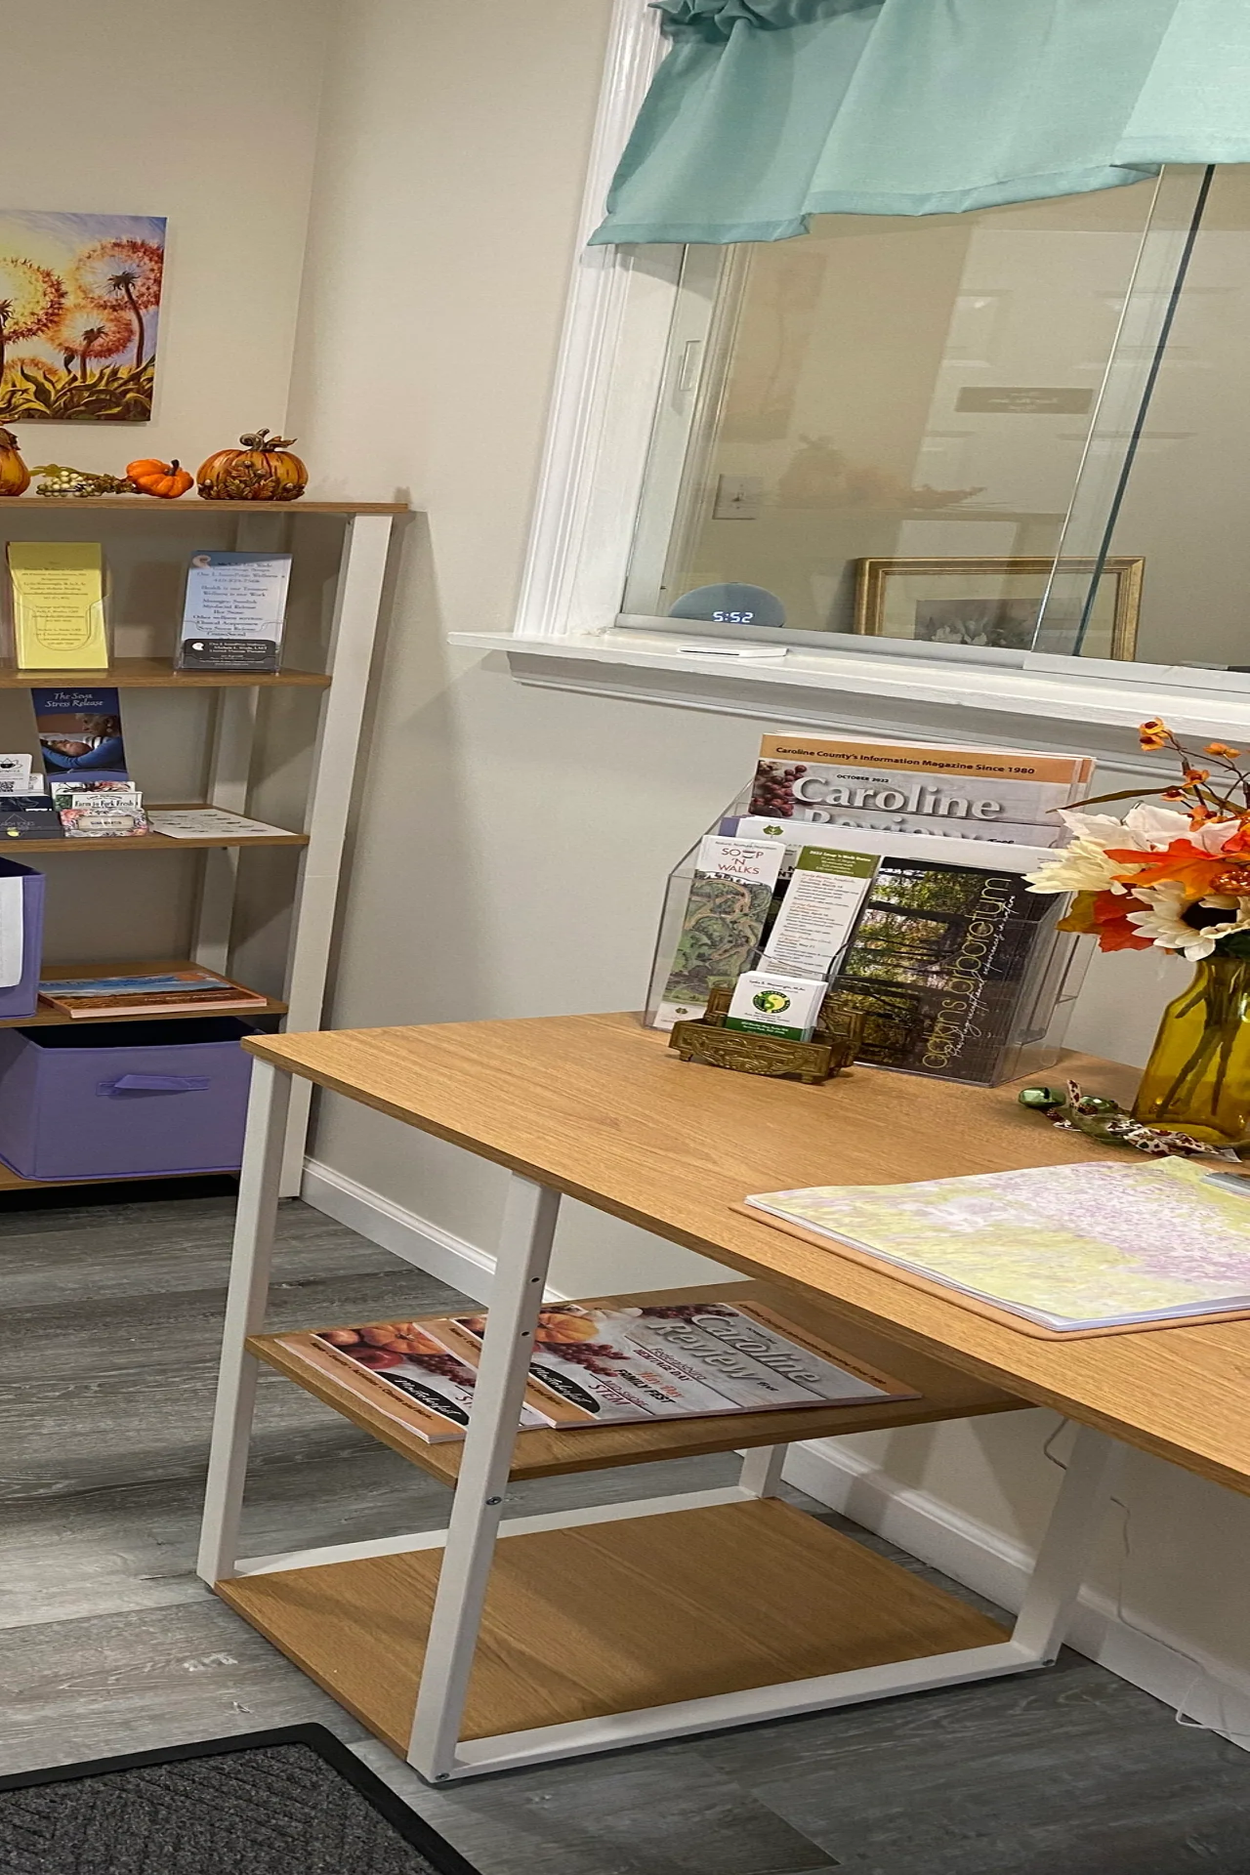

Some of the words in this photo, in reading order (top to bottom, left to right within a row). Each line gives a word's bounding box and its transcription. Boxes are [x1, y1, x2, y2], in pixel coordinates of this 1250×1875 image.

[712, 611, 754, 623] 5:52
[45, 700, 70, 708] Stress
[72, 699, 104, 707] Release
[53, 692, 71, 700] The
[776, 747, 815, 756] Caroline
[817, 750, 858, 760] County's
[860, 754, 920, 765] Information
[922, 760, 973, 770] Magazine
[976, 764, 1005, 772] Since
[792, 776, 1001, 819] Caroline
[718, 864, 760, 875] WALKS
[945, 877, 1013, 994] arboretum
[922, 999, 967, 1069] adkins
[645, 1322, 761, 1380] Review
[691, 1314, 820, 1383] Caroline
[588, 1384, 631, 1406] STEM
[614, 1369, 651, 1394] FAMILY
[649, 1388, 676, 1403] FEST
